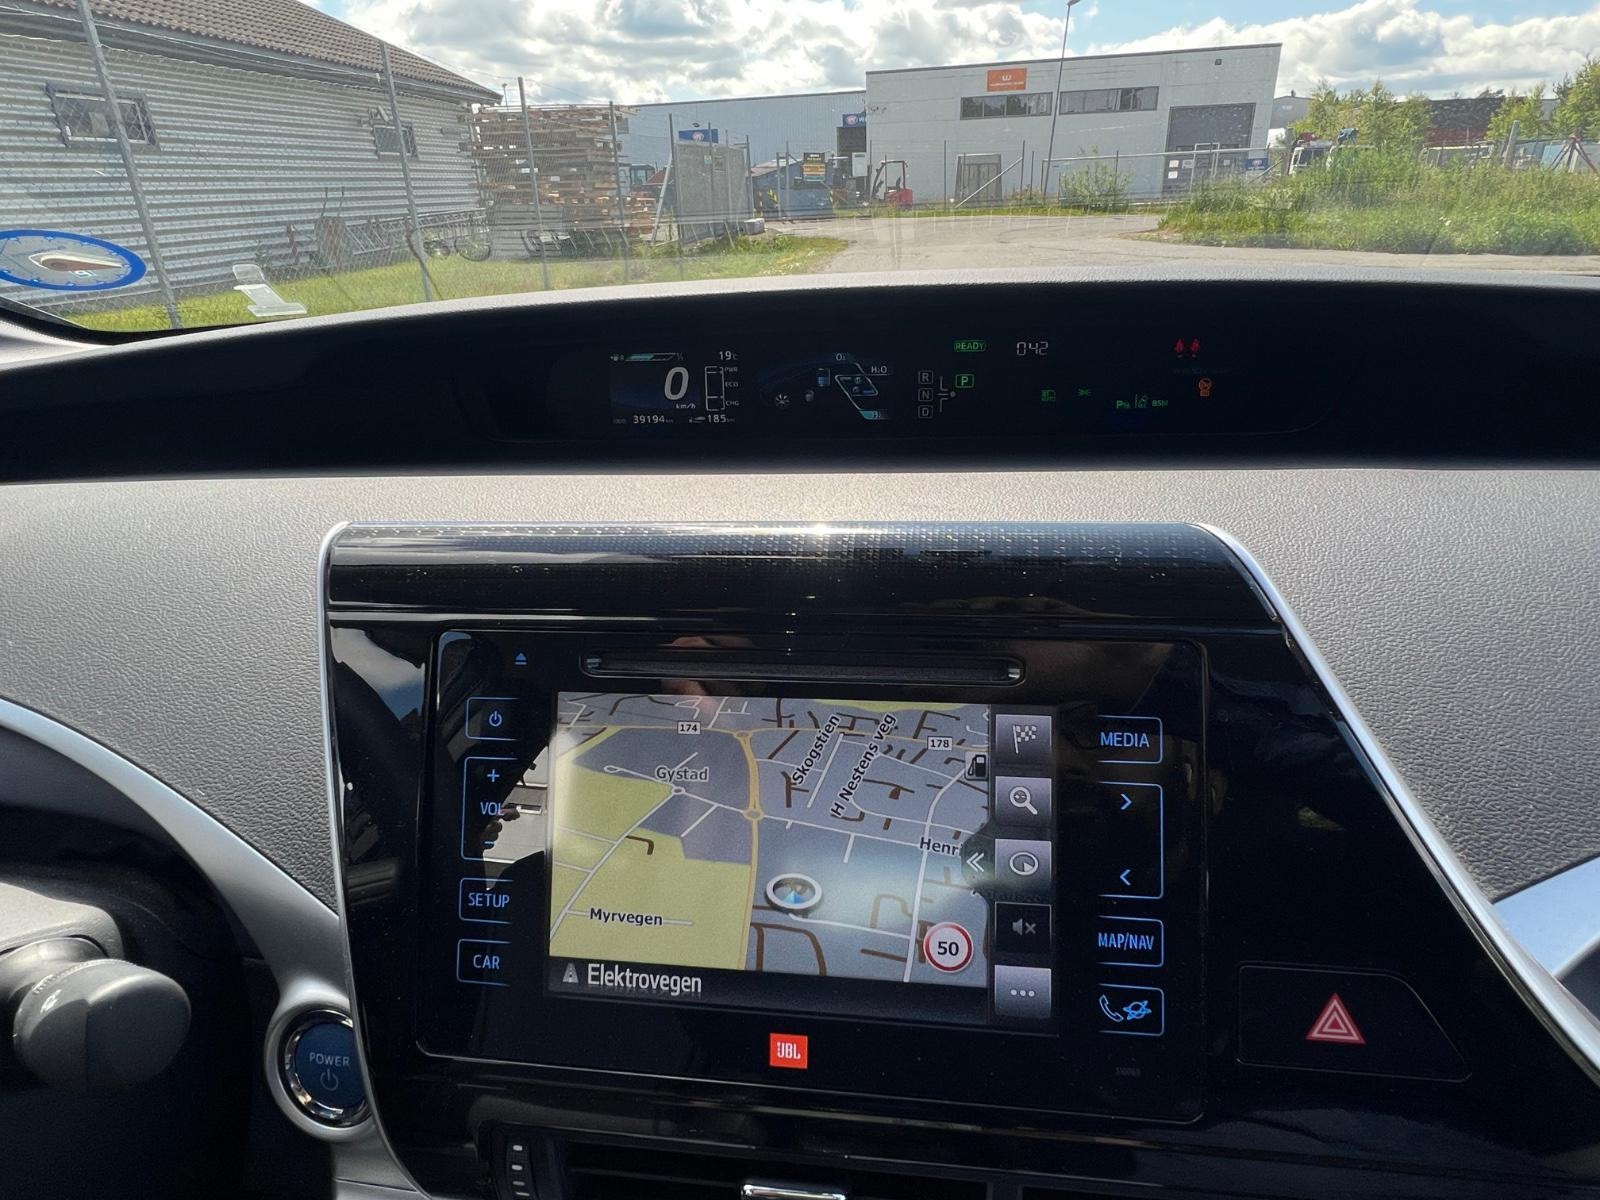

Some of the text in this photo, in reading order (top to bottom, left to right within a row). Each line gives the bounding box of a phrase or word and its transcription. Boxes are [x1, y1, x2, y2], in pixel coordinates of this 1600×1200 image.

[955, 341, 984, 351] READY
[664, 366, 690, 401] 0
[921, 372, 930, 382] R
[960, 376, 969, 386] P
[921, 390, 930, 400] N
[675, 402, 697, 410] km/h
[921, 407, 930, 417] D
[633, 414, 665, 425] 39194
[707, 414, 727, 424] 185
[680, 723, 698, 733] 174
[929, 739, 950, 749] 178
[1100, 731, 1150, 748] MEDIA
[792, 714, 841, 785] Skogstien
[830, 713, 898, 816] H Nestens veg
[656, 767, 709, 782] Gystad
[480, 801, 504, 817] VOL
[468, 892, 511, 908] SETUP
[590, 907, 664, 928] Myrvegen
[937, 940, 960, 957] 50
[1097, 931, 1155, 951] MAP/NAV
[473, 953, 500, 971] CAR
[587, 962, 703, 997] Elektrovegen
[776, 1041, 802, 1060] JBL
[309, 1052, 351, 1067] POWER
